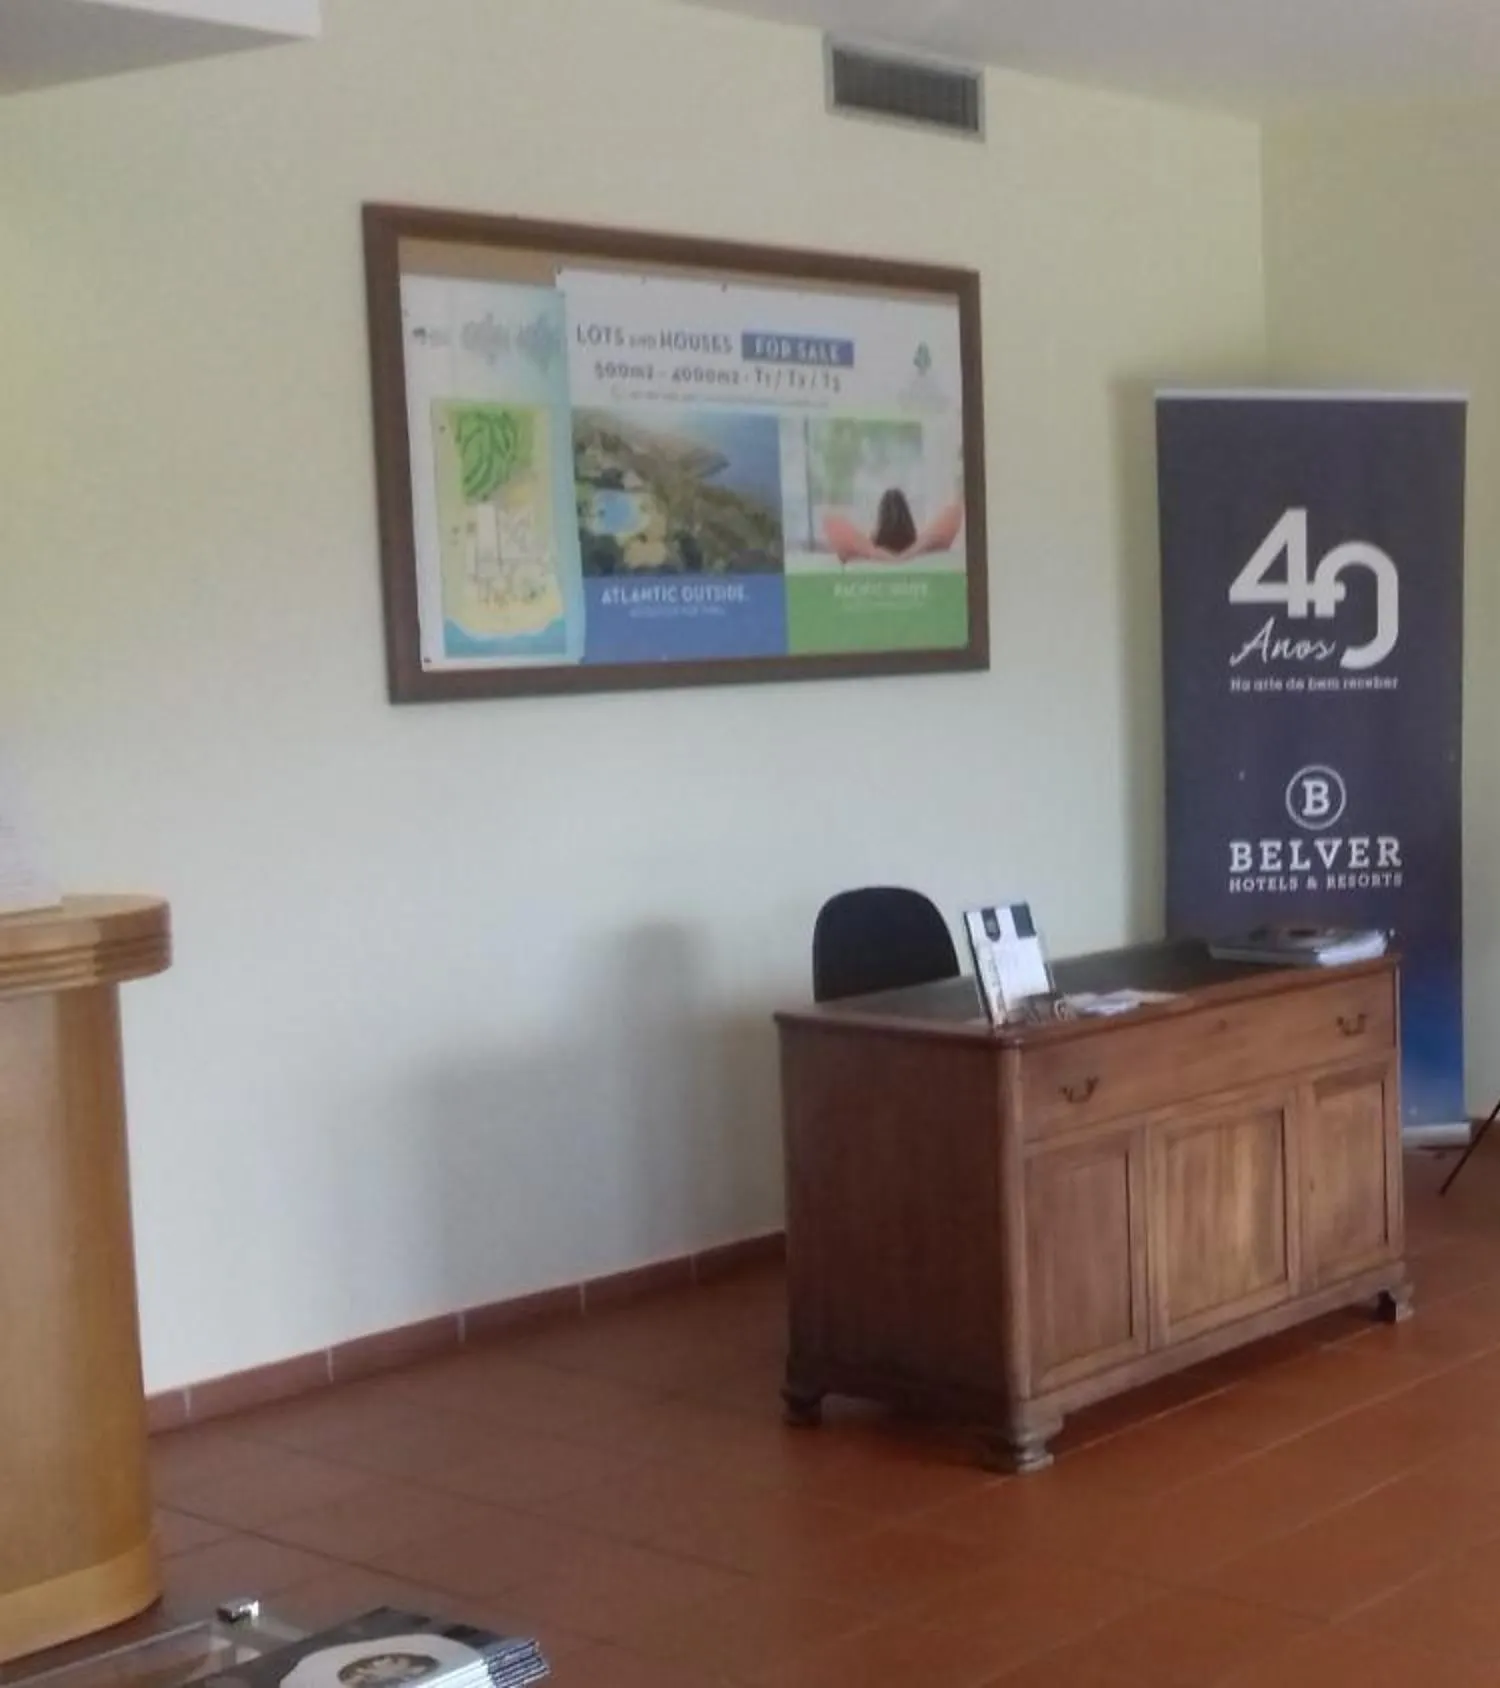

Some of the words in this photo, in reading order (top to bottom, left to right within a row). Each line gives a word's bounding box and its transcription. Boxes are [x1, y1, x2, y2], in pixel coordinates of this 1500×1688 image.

[576, 323, 625, 347] LOTS
[660, 329, 734, 353] HOUSES
[755, 335, 791, 359] FOR
[797, 340, 840, 364] SALE
[601, 584, 678, 606] ATLANTIC
[1229, 506, 1399, 669] 40
[1229, 616, 1337, 667] Anos
[1285, 676, 1305, 691] de
[1307, 676, 1340, 692] bem
[1343, 675, 1399, 691] receber
[1303, 779, 1331, 817] B
[1229, 836, 1402, 873] BELVER
[1229, 875, 1299, 894] HOTELS
[1305, 875, 1318, 891] &
[1326, 870, 1404, 890] RESORTS
